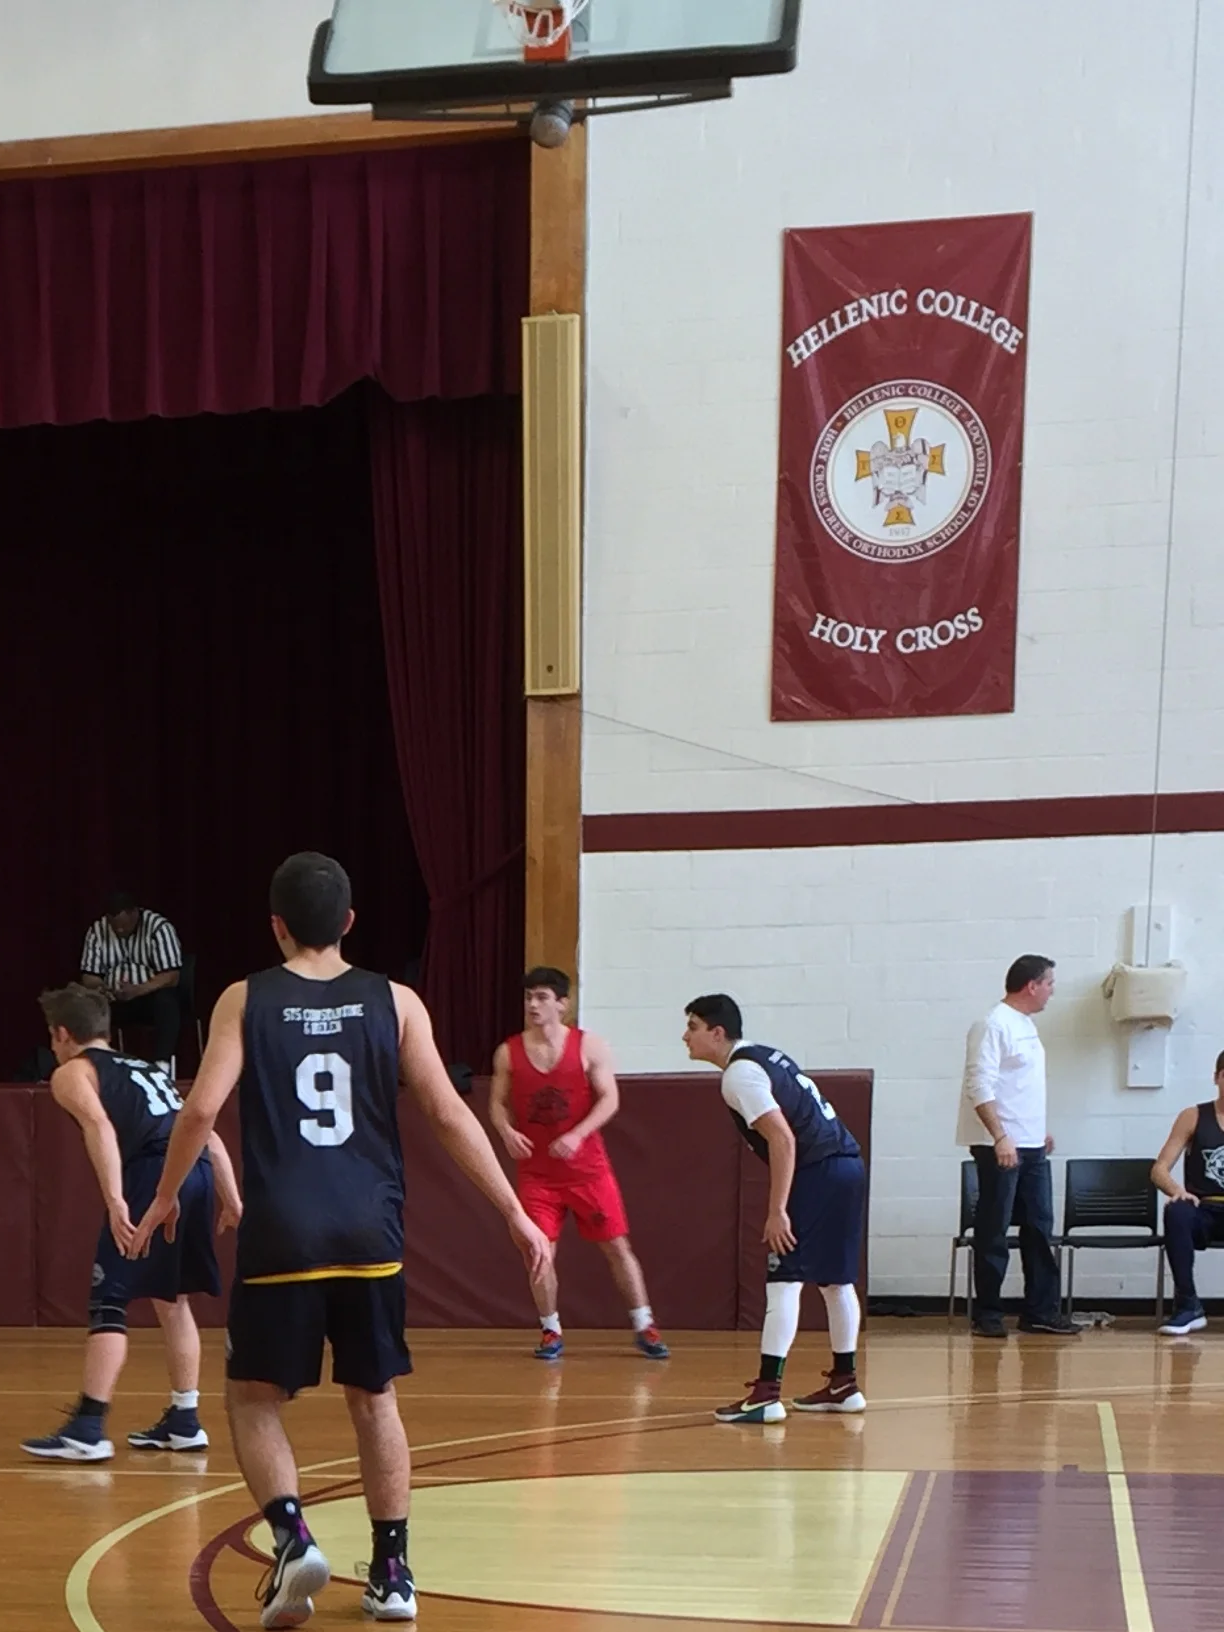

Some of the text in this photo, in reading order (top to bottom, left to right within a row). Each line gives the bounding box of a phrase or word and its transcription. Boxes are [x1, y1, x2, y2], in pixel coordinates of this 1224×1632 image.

[786, 288, 1024, 368] HELLENIC COLLEGE
[843, 385, 963, 420] HELLENIC COLLEGE
[823, 507, 854, 542] GREEK
[852, 539, 924, 557] ORTHODOX
[926, 510, 970, 548] SCHOOL
[809, 607, 983, 653] HOLY CROSS
[295, 1053, 355, 1147] 9
